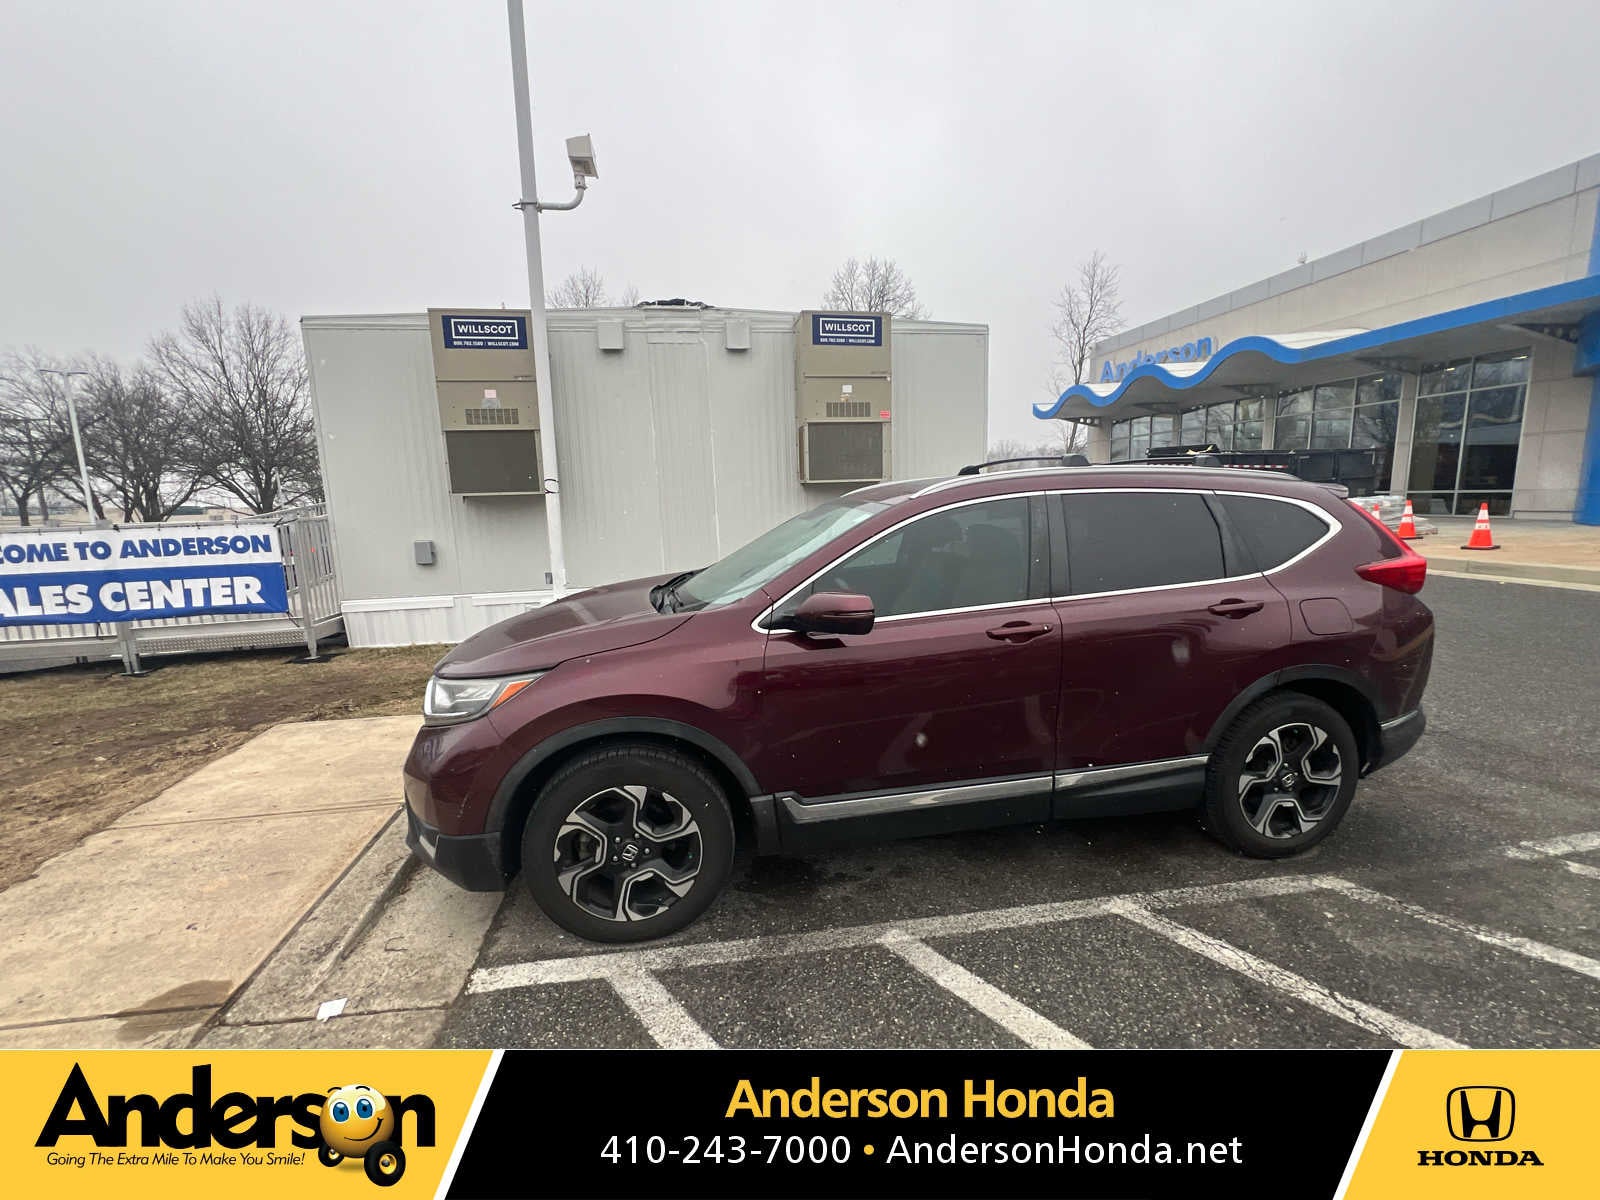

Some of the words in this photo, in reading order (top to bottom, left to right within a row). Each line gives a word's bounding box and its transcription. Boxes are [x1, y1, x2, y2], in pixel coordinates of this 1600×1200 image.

[457, 324, 513, 335] WILLSCOT
[824, 323, 872, 333] WILLSCOT
[0, 543, 70, 564] OME
[73, 541, 112, 560] TO
[120, 534, 273, 559] ANDERSON
[99, 575, 266, 613] CENTER
